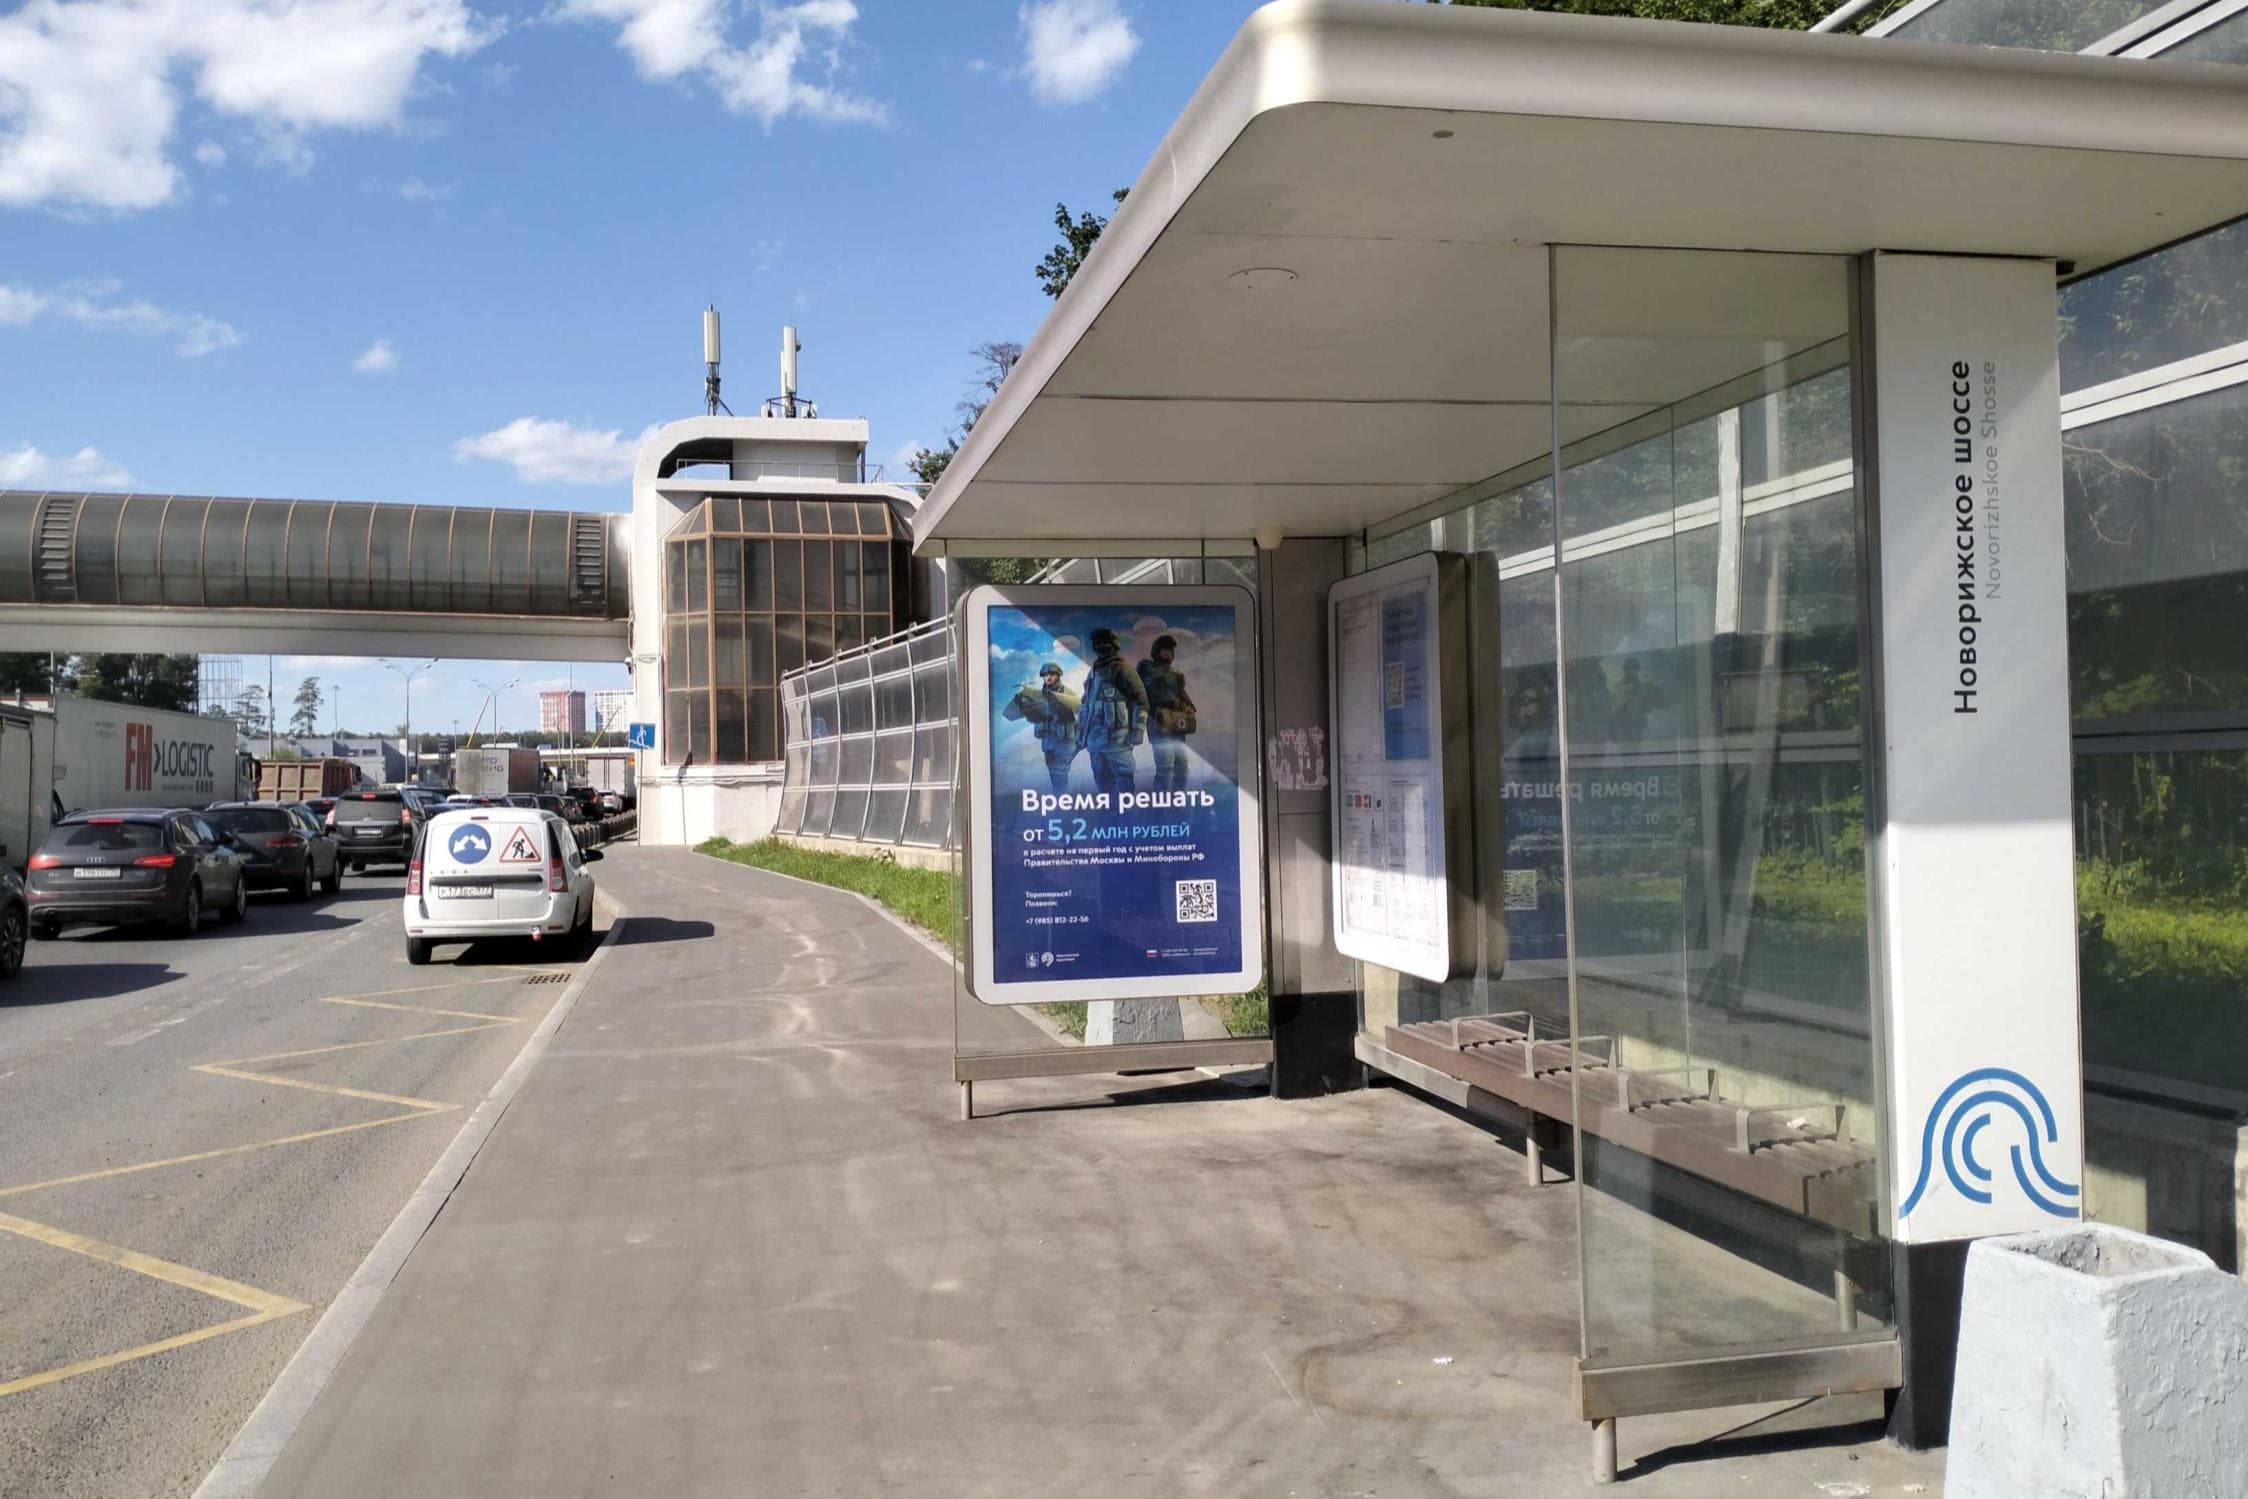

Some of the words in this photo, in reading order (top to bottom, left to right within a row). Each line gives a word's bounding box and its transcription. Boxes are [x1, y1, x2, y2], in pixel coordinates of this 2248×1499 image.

[1952, 360, 1973, 463] шоссе
[1980, 360, 1998, 439] Shosse
[1981, 445, 2001, 600] Novorizhskoe
[1954, 474, 1981, 714] Новорижское
[125, 722, 153, 791] FM
[161, 740, 214, 778] LOGISTIC
[1022, 789, 1110, 816] Время
[1118, 790, 1215, 814] решать
[1048, 818, 1088, 844] 5,2
[1091, 826, 1128, 840] МЛН
[1132, 822, 1190, 839] РУБЛЕЙ
[1023, 858, 1089, 868] Правительства
[1090, 856, 1125, 865] Москвы
[1134, 853, 1190, 864] Минобороны
[1192, 852, 1205, 862] РФ
[1030, 848, 1065, 858] расчете
[1066, 848, 1077, 856] на
[1078, 846, 1111, 856] первый
[1112, 846, 1127, 855] год
[1134, 845, 1165, 855] учетом
[1166, 843, 1197, 852] выплат
